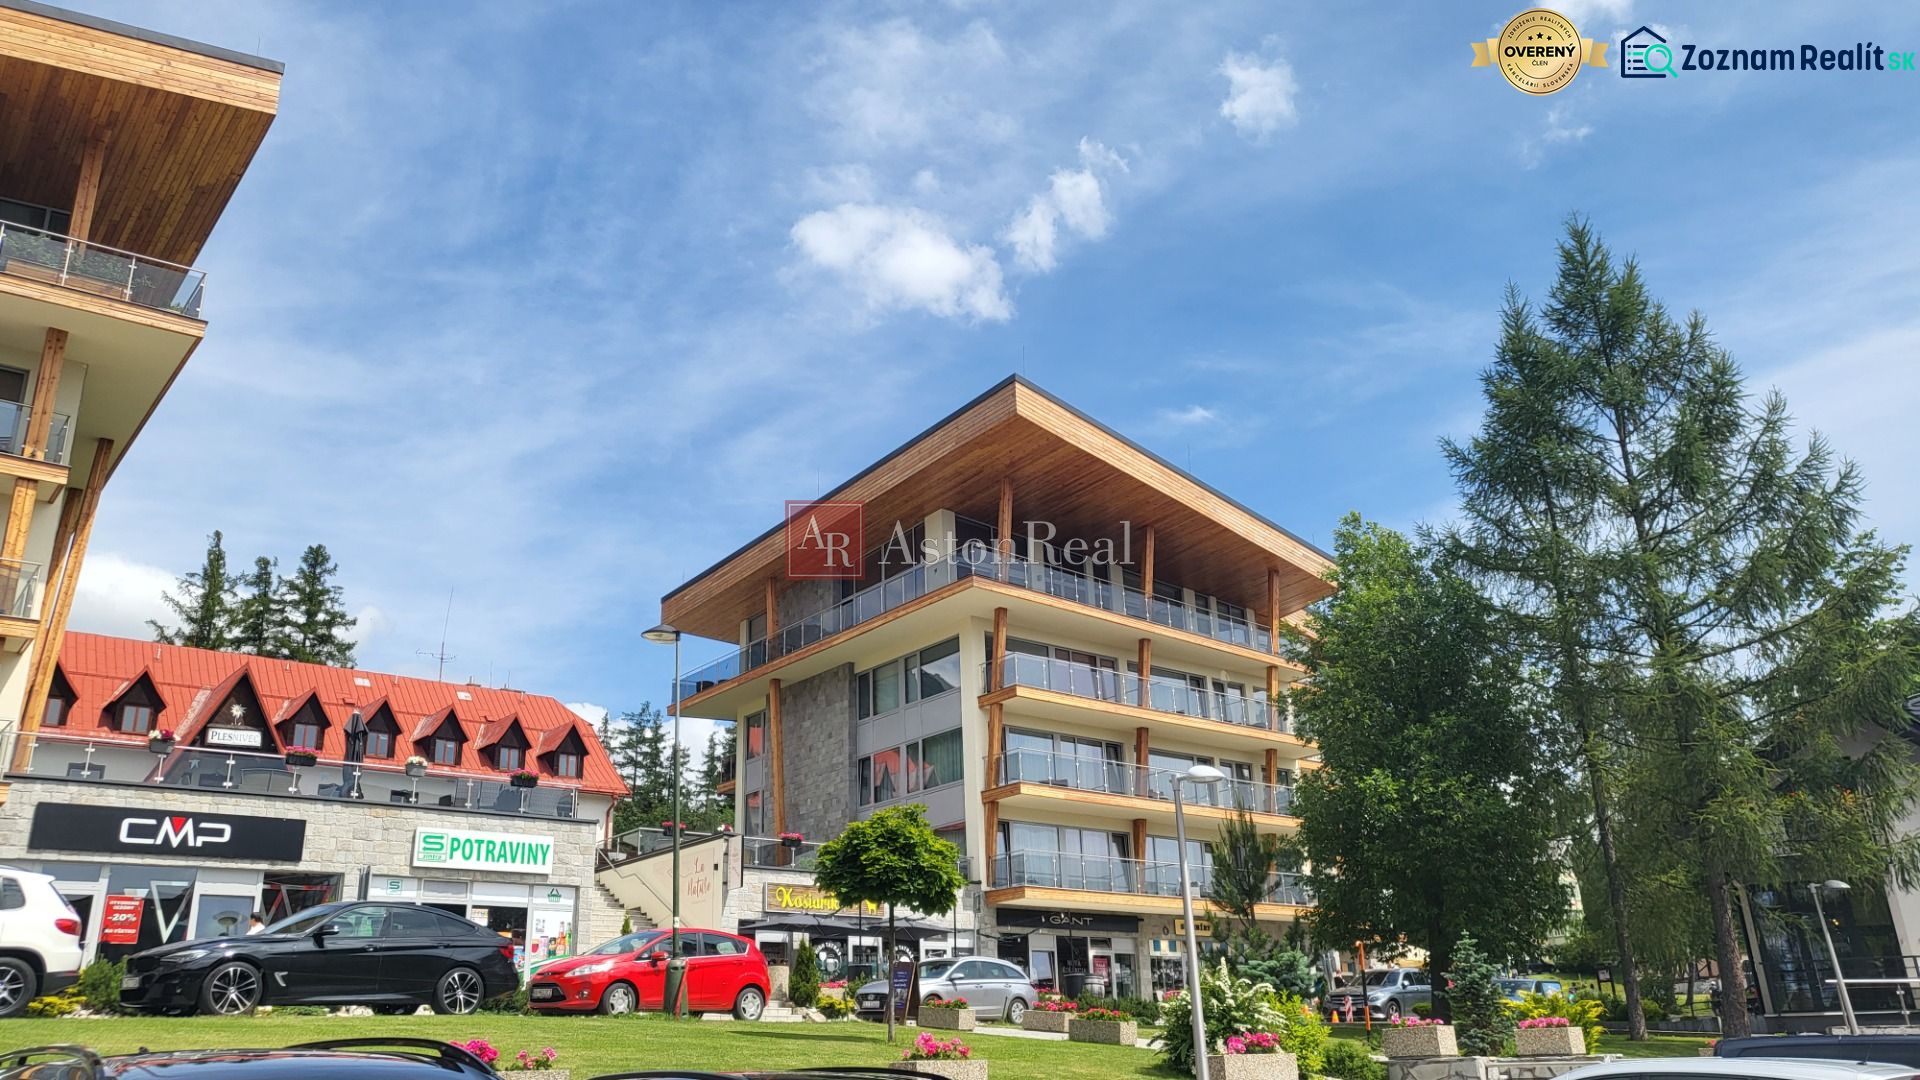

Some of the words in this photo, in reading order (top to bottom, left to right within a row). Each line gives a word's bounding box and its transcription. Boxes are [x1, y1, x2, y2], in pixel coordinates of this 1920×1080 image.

[119, 816, 232, 848] CMP
[449, 837, 551, 866] POTRAVINY
[106, 913, 137, 921] -20%
[1049, 915, 1093, 926] GANT
